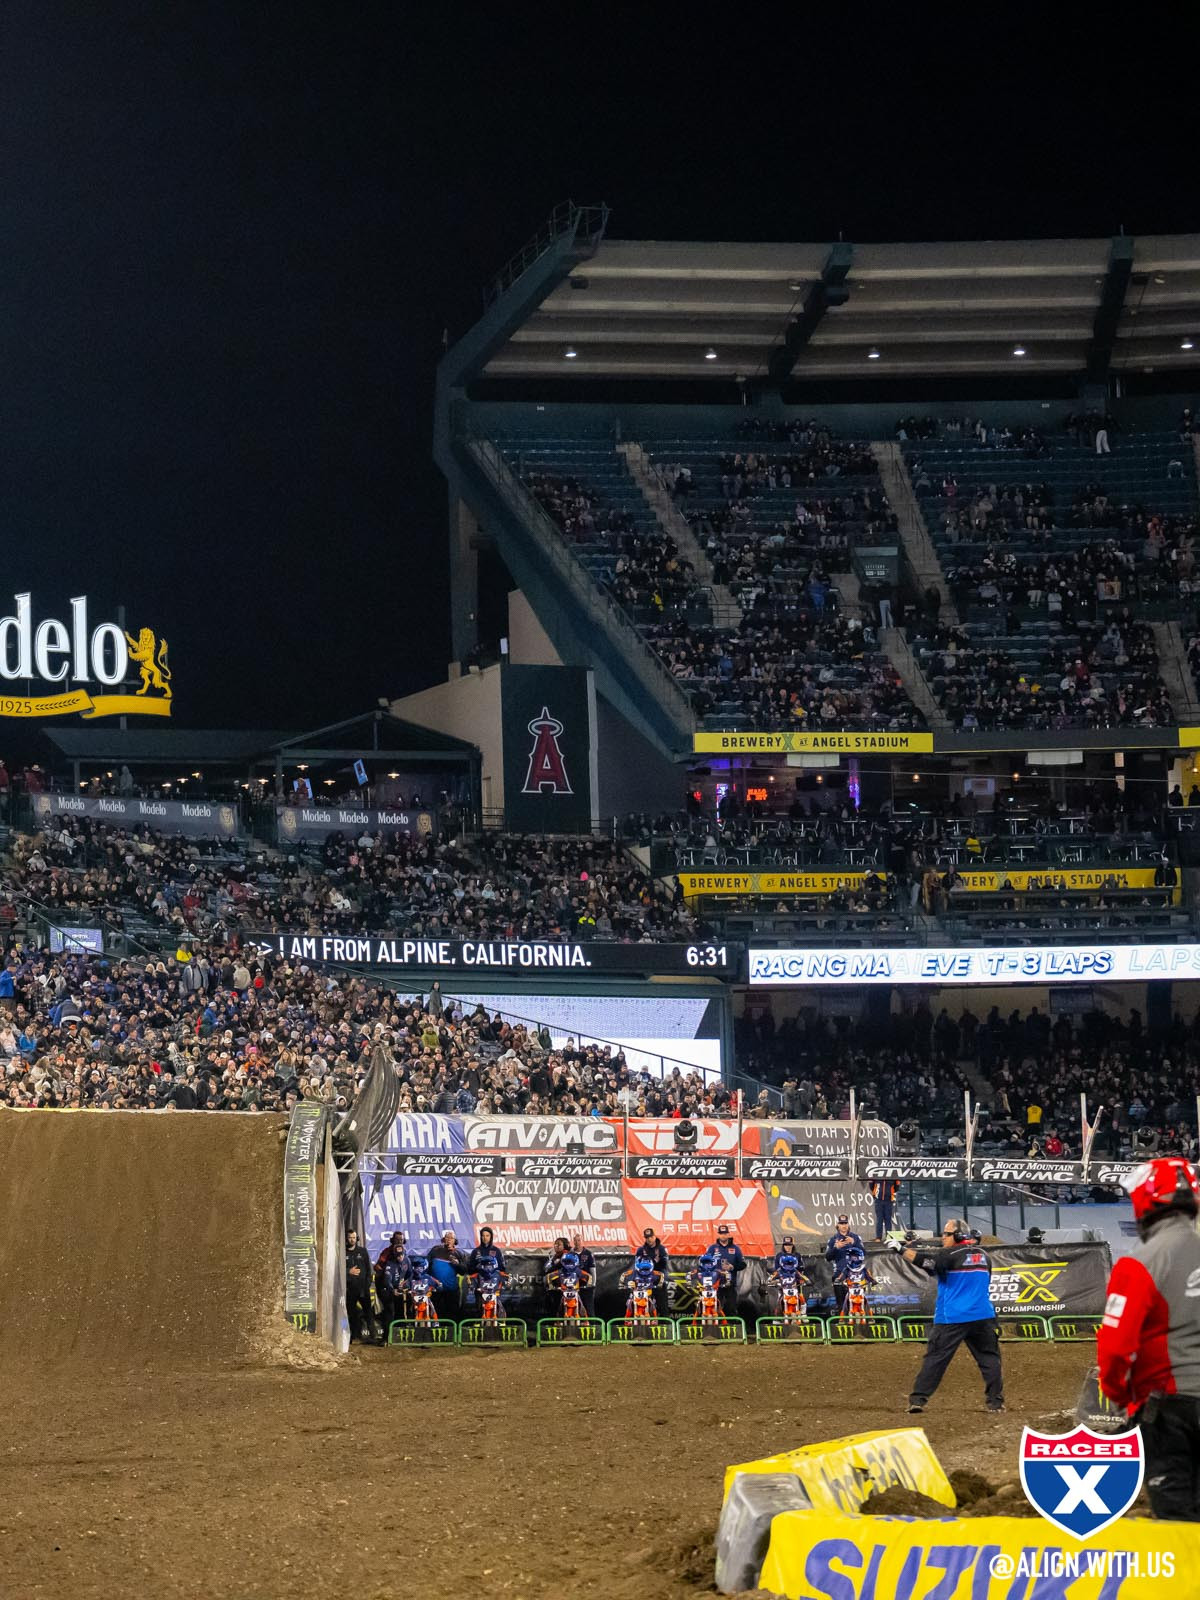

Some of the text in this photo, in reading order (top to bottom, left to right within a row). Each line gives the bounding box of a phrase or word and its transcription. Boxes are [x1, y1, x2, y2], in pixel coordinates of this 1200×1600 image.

[1, 700, 32, 714] 1925
[722, 736, 781, 748] BREWERY
[813, 736, 850, 748] ANGEL
[855, 736, 909, 748] STADIUM
[521, 706, 574, 794] A
[58, 797, 85, 810] Modelo
[99, 800, 126, 813] Modelo
[139, 802, 166, 815] Modelo
[182, 804, 211, 817] Modelo
[302, 809, 331, 822] Modelo
[339, 811, 369, 824] Modelo
[378, 812, 409, 824] Modelo
[690, 877, 749, 888] BREWERY
[780, 877, 818, 888] ANGEL
[291, 937, 316, 960] AM
[323, 939, 371, 962] FROM
[377, 941, 456, 965] ALPINE,
[462, 943, 592, 967] CALIFORNIA.
[686, 946, 727, 966] 6:31
[1045, 952, 1112, 975] LAPS
[805, 1126, 888, 1138] UTAH SORTS
[448, 1156, 494, 1164] MOUNTAIN
[537, 1157, 613, 1165] ROCKY MOUNTAIN
[650, 1157, 727, 1166] ROCKY MOUNTAIN
[764, 1159, 841, 1167] ROCKY MOUNTAIN
[880, 1159, 958, 1168] ROCKY MOUNTAIN
[996, 1161, 1074, 1172] ROCKY MOUNTAIN
[494, 1178, 620, 1195] ROCKY MOUNTAIN
[628, 1187, 759, 1221] FLY
[812, 1193, 874, 1207] UTAH SPO
[990, 1274, 1020, 1283] PER
[988, 1284, 1019, 1292] OTO
[989, 1293, 1020, 1301] OSS
[1002, 1304, 1066, 1313] CHAMPIONSHIP
